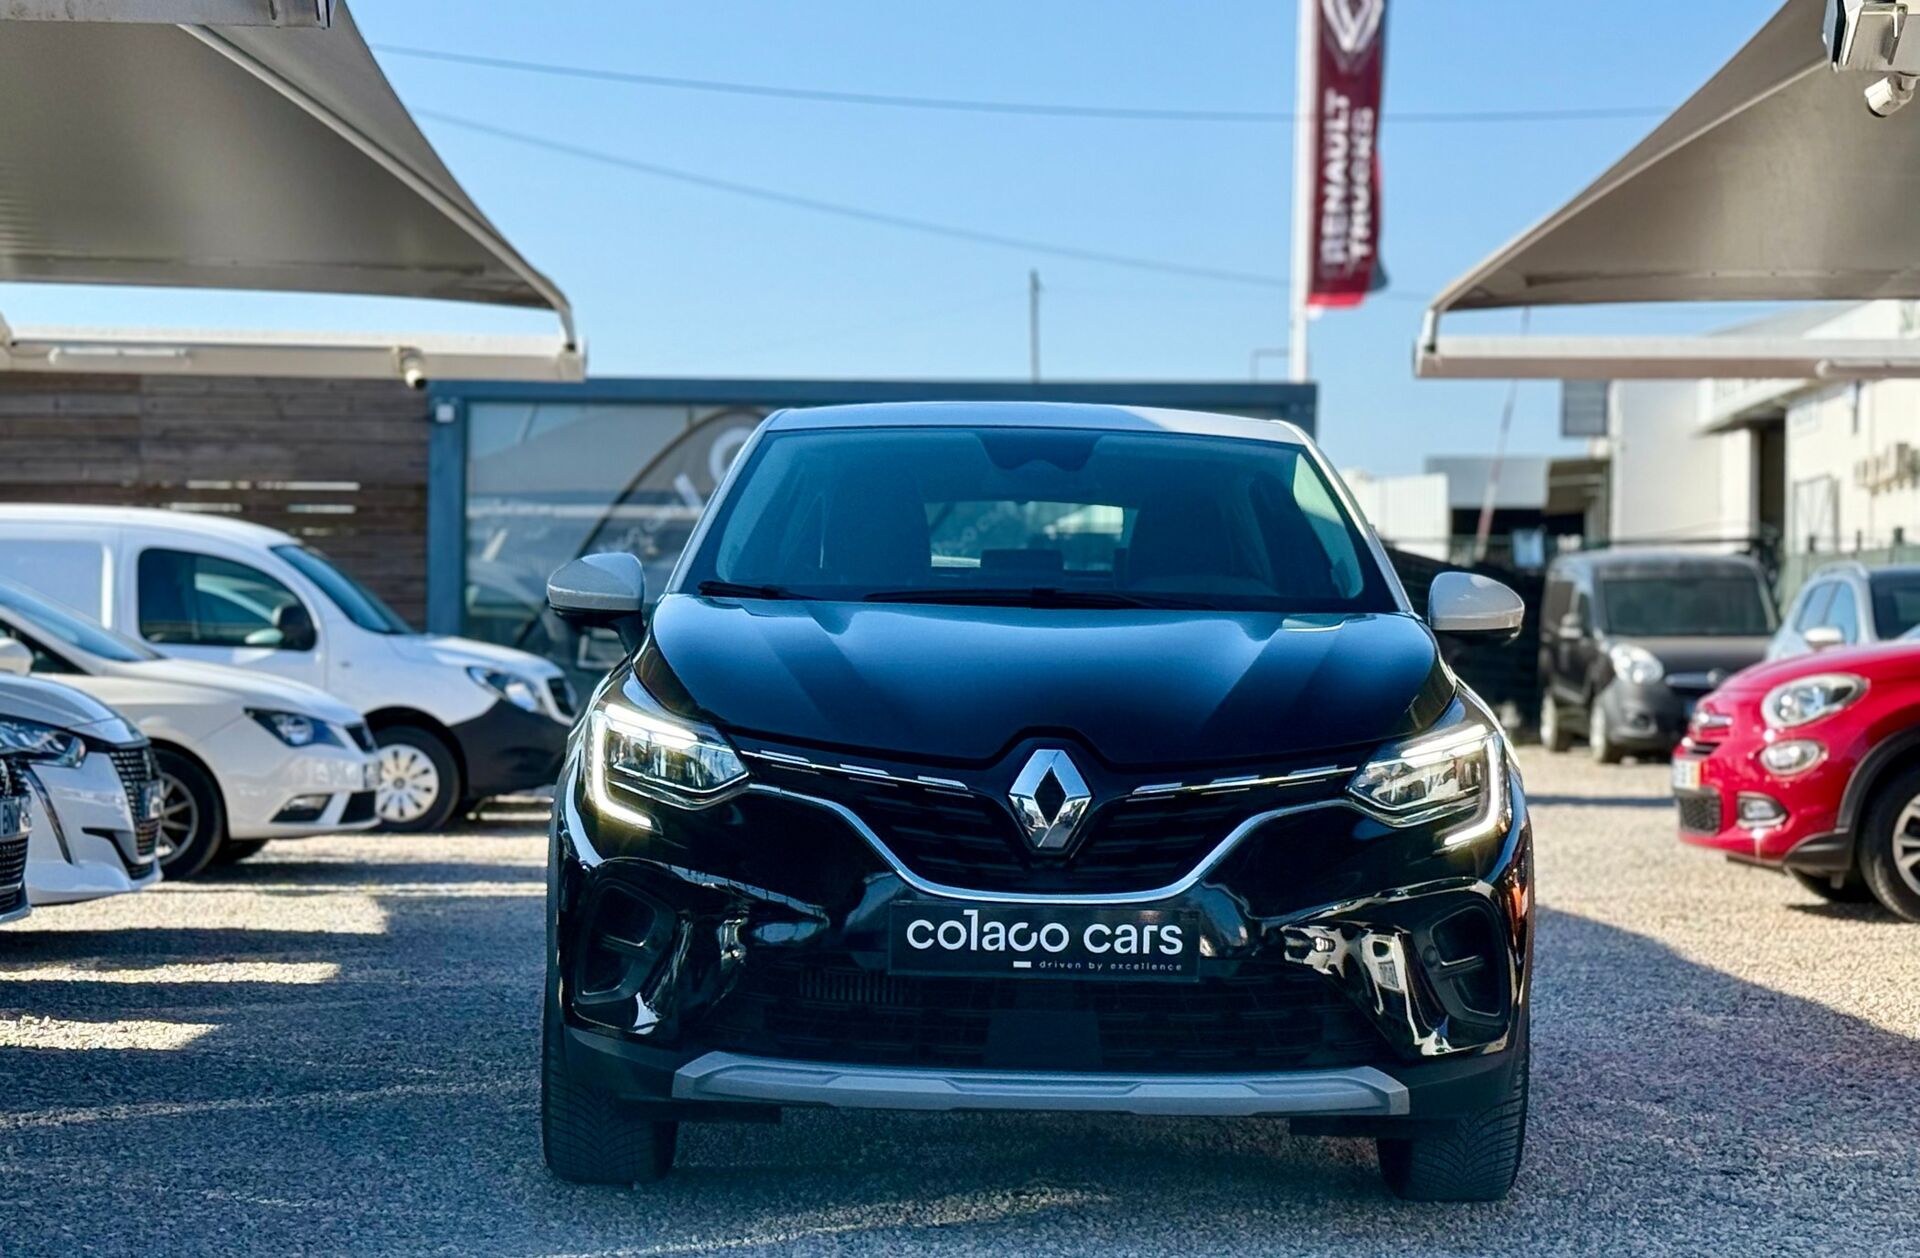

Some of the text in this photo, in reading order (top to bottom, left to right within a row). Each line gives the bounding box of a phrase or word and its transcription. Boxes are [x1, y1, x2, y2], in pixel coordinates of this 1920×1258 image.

[1321, 88, 1350, 264] RENAULT
[1350, 106, 1374, 258] TRUCKS
[1039, 960, 1183, 972] driven by excellence
[1083, 923, 1183, 955] cars
